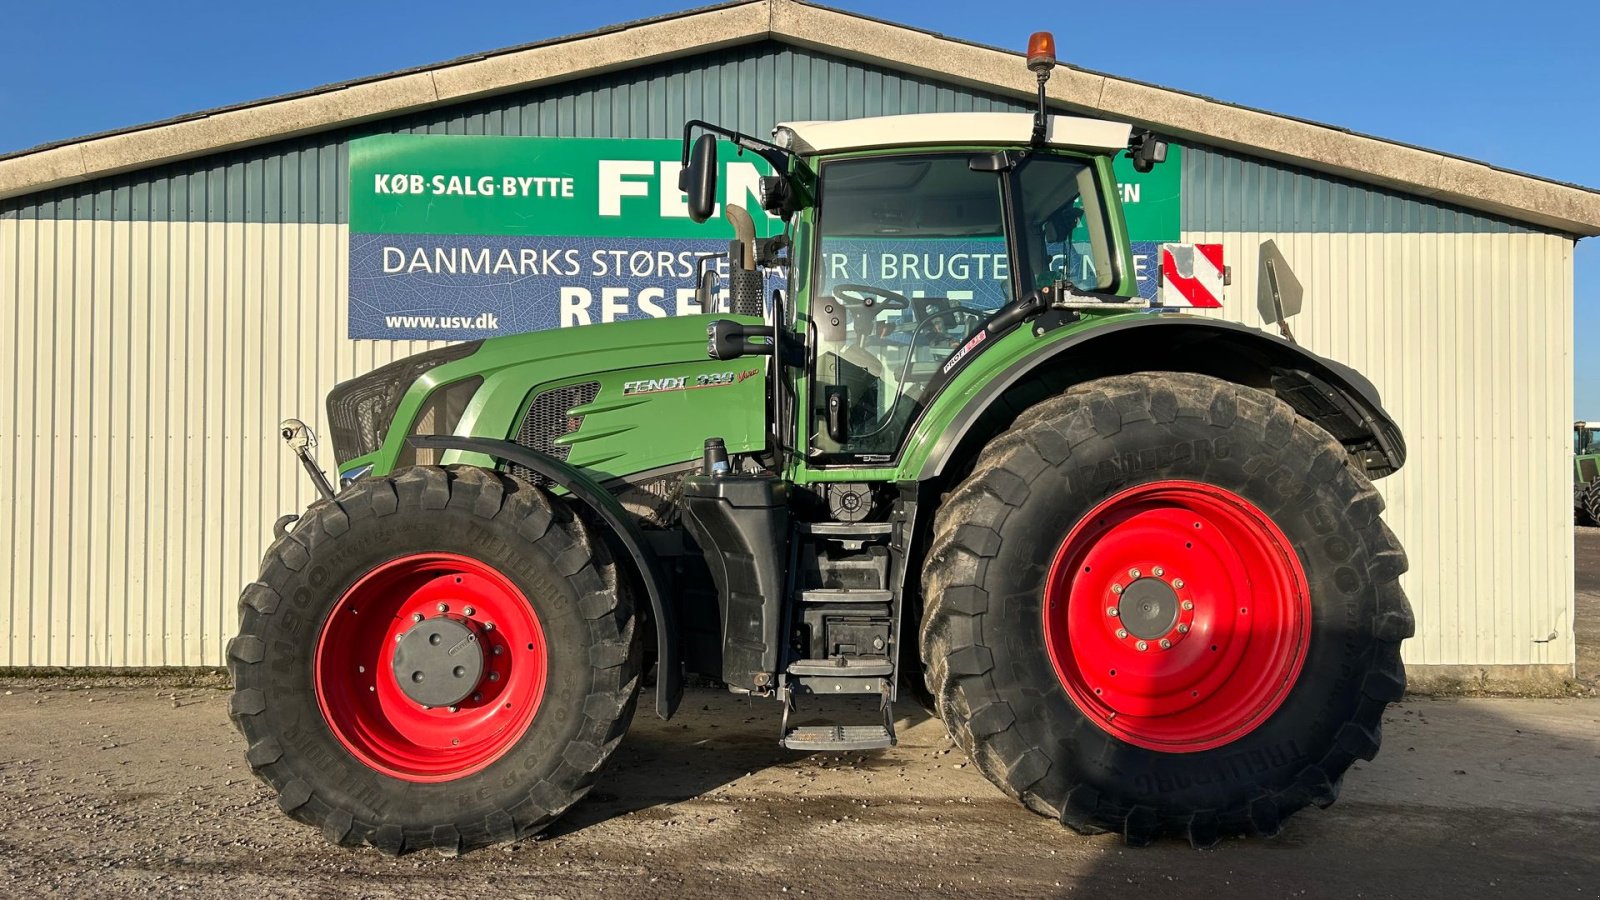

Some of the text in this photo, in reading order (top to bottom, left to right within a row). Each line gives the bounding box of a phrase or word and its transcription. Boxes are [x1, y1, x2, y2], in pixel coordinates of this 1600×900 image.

[383, 246, 580, 276] DANMARKS
[881, 253, 1008, 280] BRUGTE
[385, 312, 499, 330] www.usv.dk
[623, 375, 690, 395] FENDT
